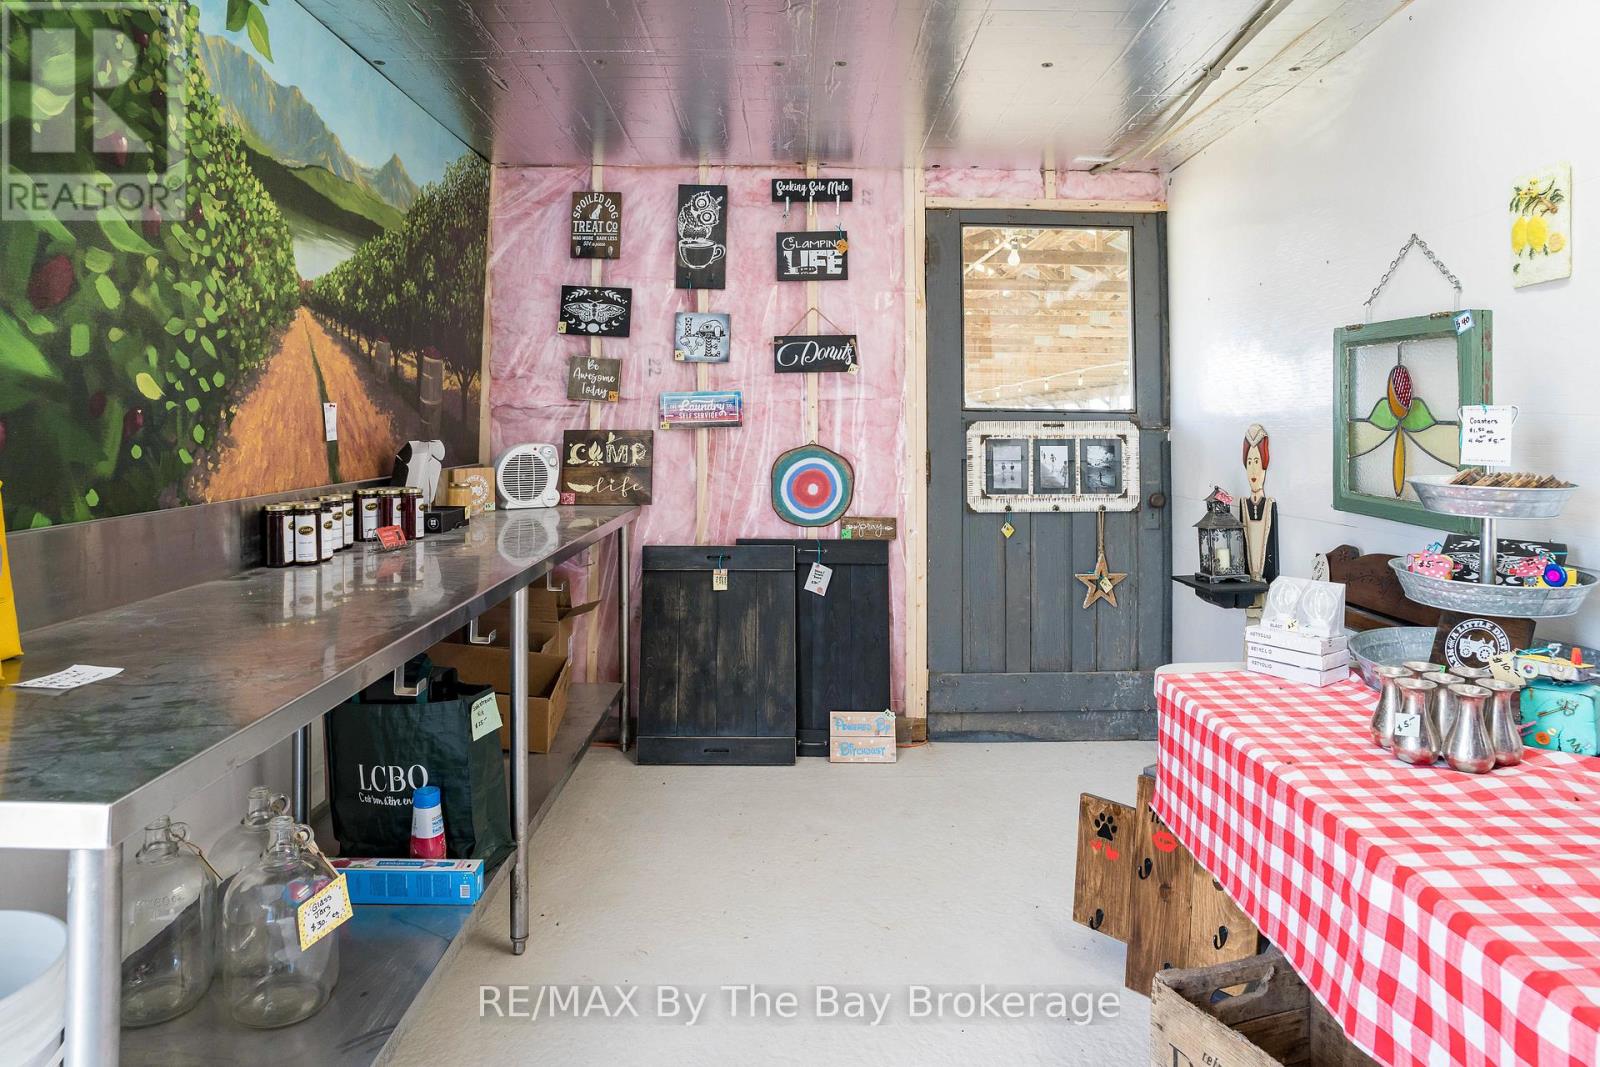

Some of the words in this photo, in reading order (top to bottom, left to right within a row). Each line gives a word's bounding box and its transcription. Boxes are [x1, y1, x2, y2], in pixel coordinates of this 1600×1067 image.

[776, 181, 807, 196] Seeking
[809, 181, 826, 196] Sole
[827, 181, 849, 195] Mate
[573, 193, 604, 219] SPOILED
[605, 198, 618, 219] DOG
[573, 221, 604, 233] TREAT
[782, 236, 838, 250] GLAMPIN
[783, 249, 843, 275] LIFE
[777, 340, 854, 366] Donuts
[587, 359, 599, 371] Be
[573, 367, 616, 384] Awesome
[581, 382, 608, 399] Today
[679, 399, 726, 416] Laundry
[694, 411, 718, 419] SERVICE
[596, 476, 643, 497] life
[1459, 620, 1494, 632] LITTLE
[1492, 625, 1508, 652] DIRT
[359, 764, 429, 792] LCBO
[311, 895, 332, 912] Glass
[313, 905, 331, 919] Jars
